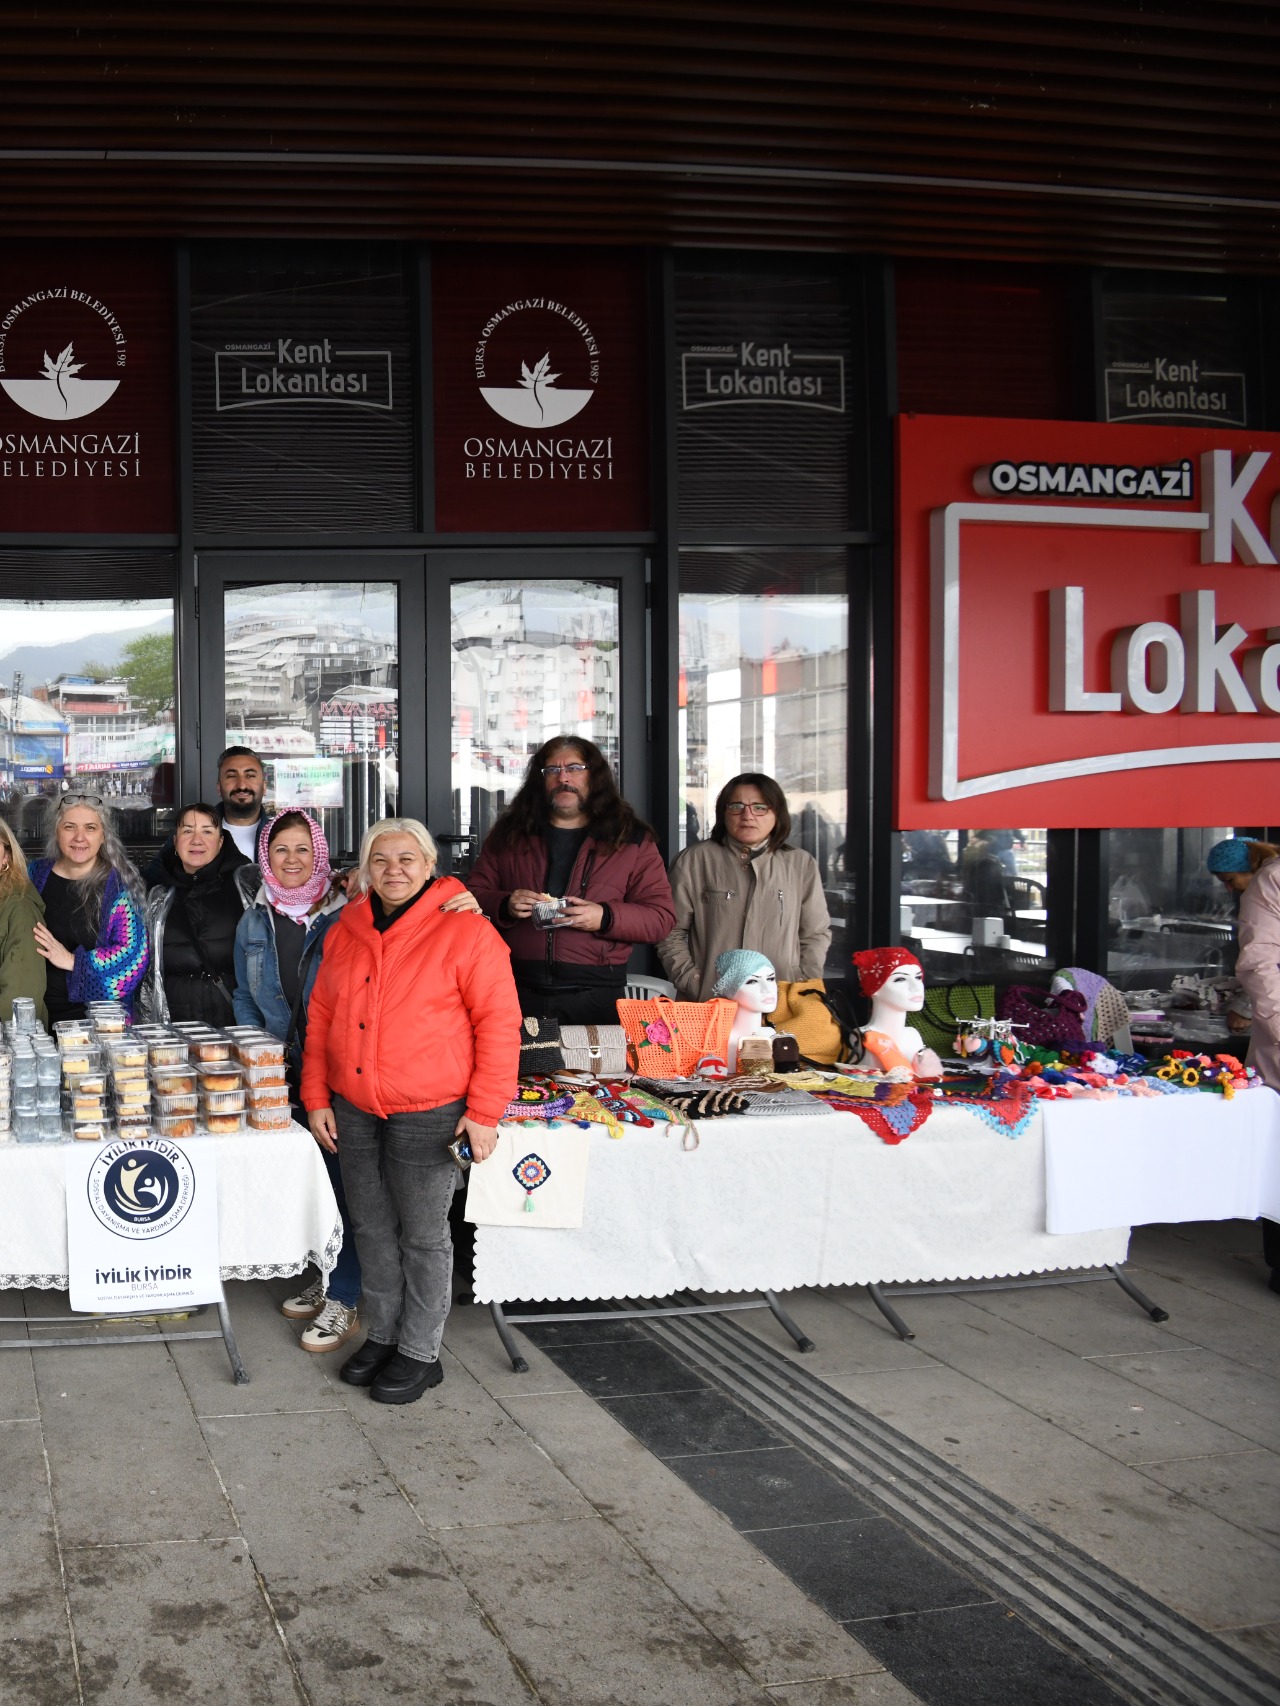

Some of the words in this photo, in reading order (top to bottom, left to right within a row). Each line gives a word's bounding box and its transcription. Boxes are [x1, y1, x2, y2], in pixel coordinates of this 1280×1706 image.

[1, 286, 67, 330] OSMANGAZİ
[70, 289, 128, 345] BELEDİYESİ
[225, 342, 271, 351] OSMANGAZİ
[278, 338, 332, 364] Kent
[475, 340, 487, 379] BURSA
[482, 297, 545, 337] OSMANGAZİ
[547, 300, 600, 356] BELEDİYESİ
[589, 359, 599, 384] 1987
[741, 342, 791, 367] Kent
[241, 367, 367, 393] Lokantası
[706, 368, 822, 396] Lokantası
[1154, 357, 1199, 382] Kent
[1125, 384, 1227, 410] Lokantası
[463, 436, 613, 458] OSMANGAZİ
[465, 460, 613, 480] BELEDİYESİ
[991, 458, 1192, 498] OSMANGAZİ
[95, 1267, 141, 1284] İYİLİK
[144, 1264, 192, 1282] İYİDİR
[131, 1282, 159, 1291] BURSA
